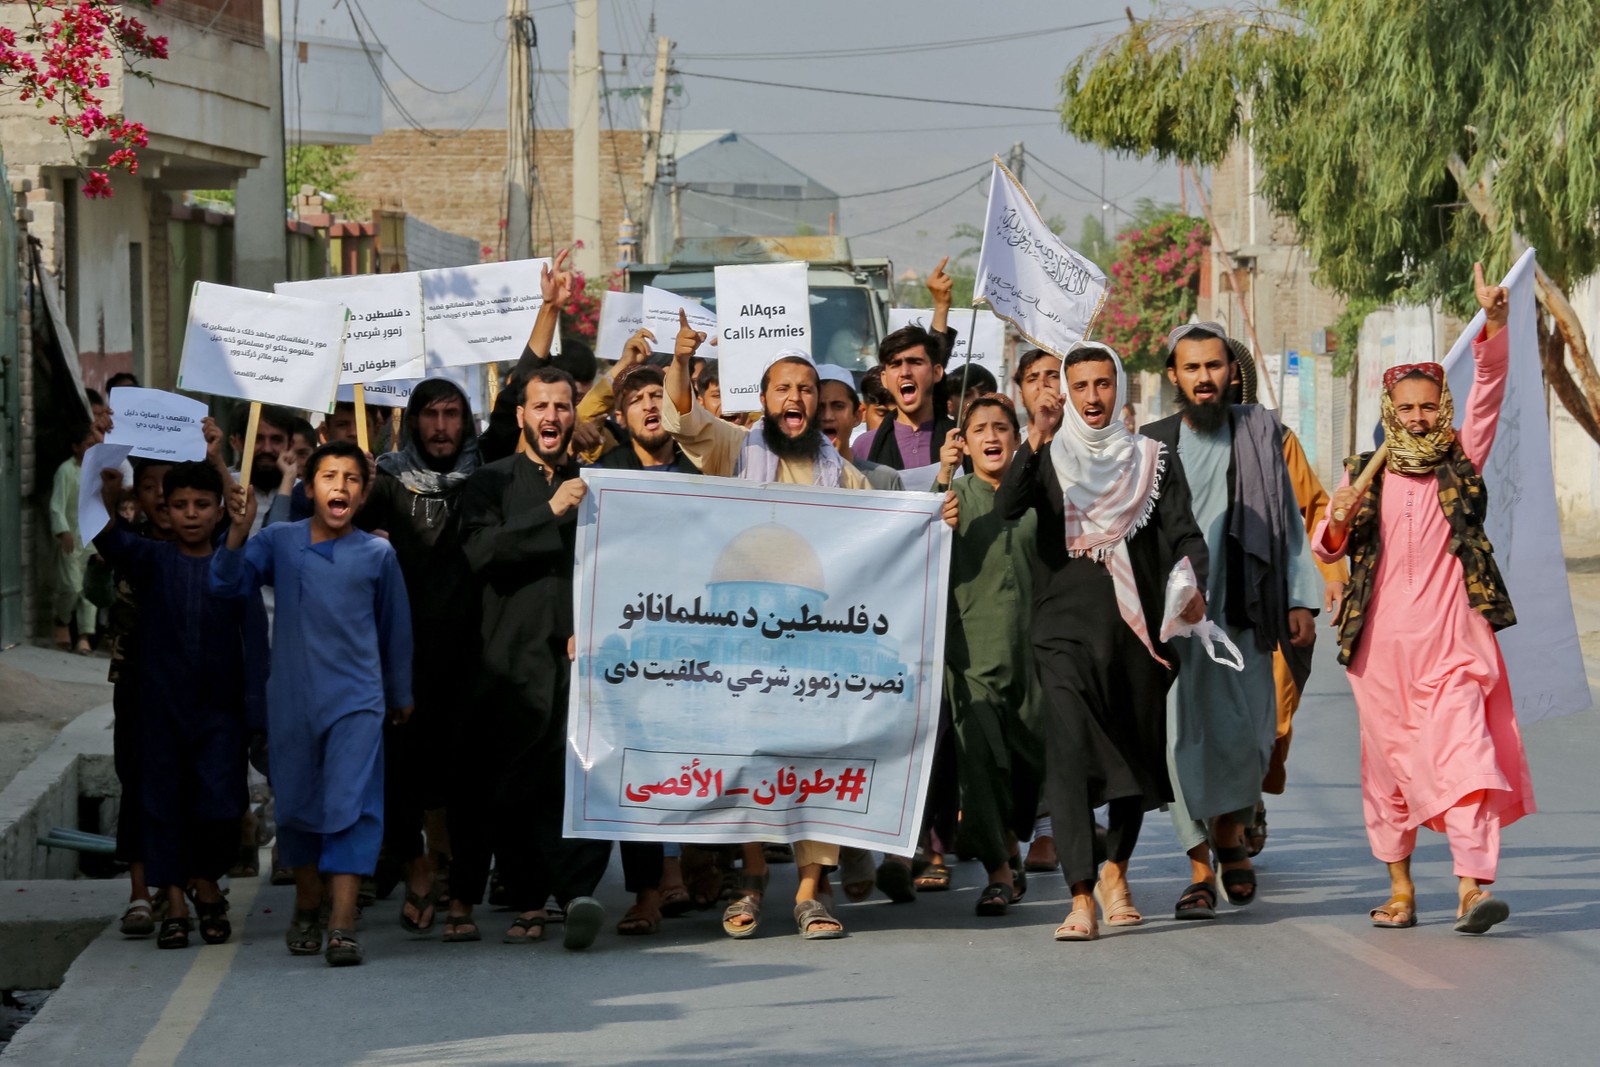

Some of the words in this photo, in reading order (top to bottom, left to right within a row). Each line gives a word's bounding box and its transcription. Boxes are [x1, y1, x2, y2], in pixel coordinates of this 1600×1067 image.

[365, 308, 404, 322] فلسطین
[740, 304, 786, 319] AlAqsa
[209, 324, 236, 334] فلسطین
[242, 328, 254, 336] خلک
[256, 330, 276, 340] مجاهد
[353, 327, 381, 340] شرعي
[724, 327, 755, 340] Calls
[758, 324, 805, 338] Armies
[265, 342, 272, 350] او
[276, 334, 309, 345] افغانستان
[618, 590, 738, 631] مسلمانانو
[742, 608, 758, 630] د
[761, 602, 868, 640] فلسطین
[873, 614, 890, 636] د
[604, 660, 640, 685] دی
[642, 659, 723, 687] مکلفیت
[727, 666, 790, 698] شرعي
[794, 672, 840, 703] زموږ
[844, 672, 904, 701] نصرت
